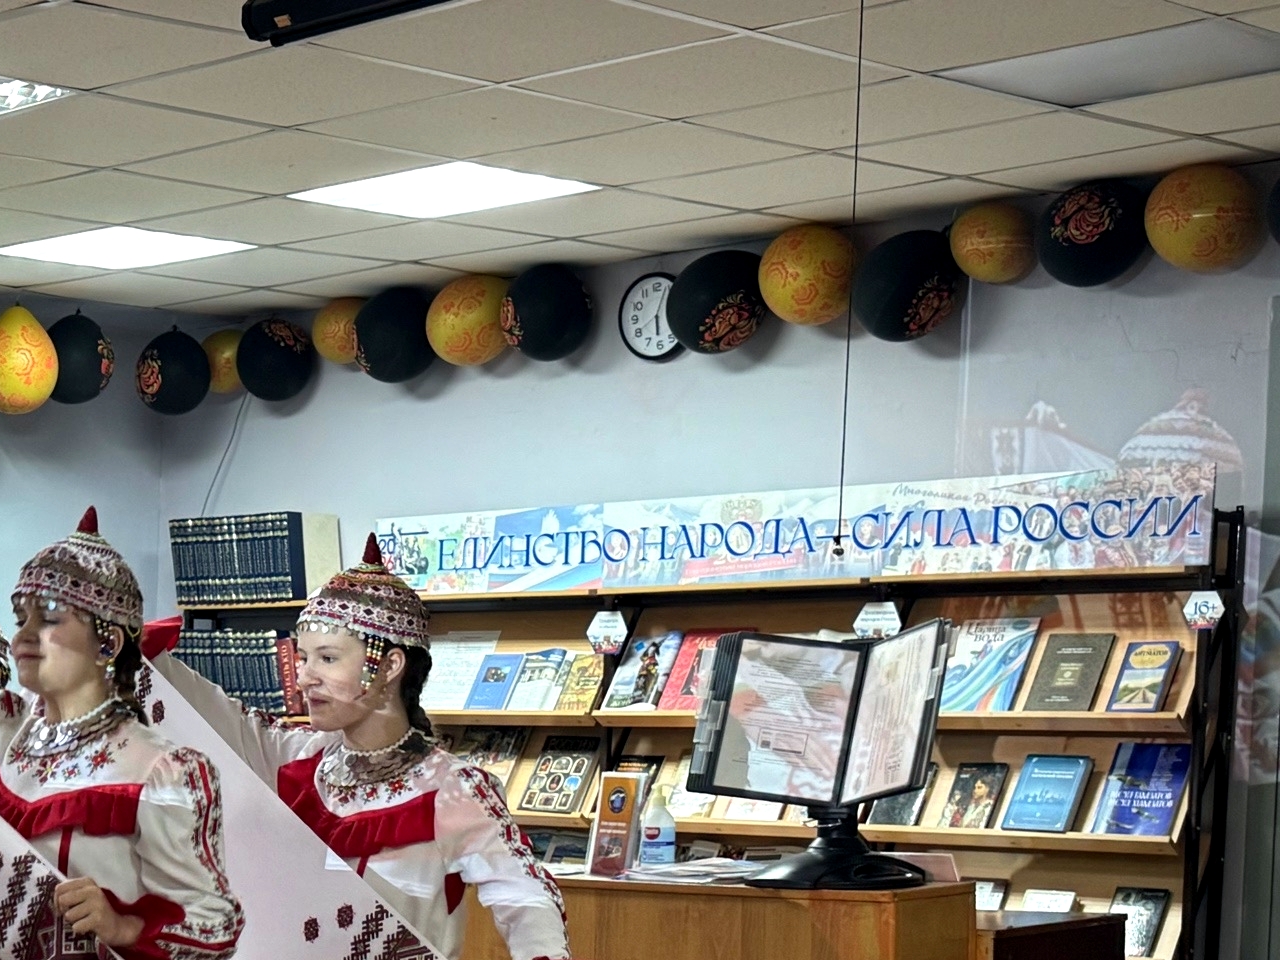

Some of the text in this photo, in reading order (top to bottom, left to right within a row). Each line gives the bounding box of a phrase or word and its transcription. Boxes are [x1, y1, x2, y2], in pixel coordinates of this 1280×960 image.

[653, 282, 662, 292] 12
[641, 289, 648, 298] 11
[633, 301, 643, 311] 10
[631, 315, 639, 324] 9
[634, 328, 642, 338] 8
[668, 333, 676, 343] 5
[645, 337, 652, 347] 7
[656, 340, 664, 350] 6
[437, 528, 631, 572] ЕДИНСТВО
[640, 516, 815, 562] НАРОДА
[851, 507, 980, 550] СИЛА
[990, 495, 1204, 544] РОССИИ
[1194, 601, 1217, 615] 16+
